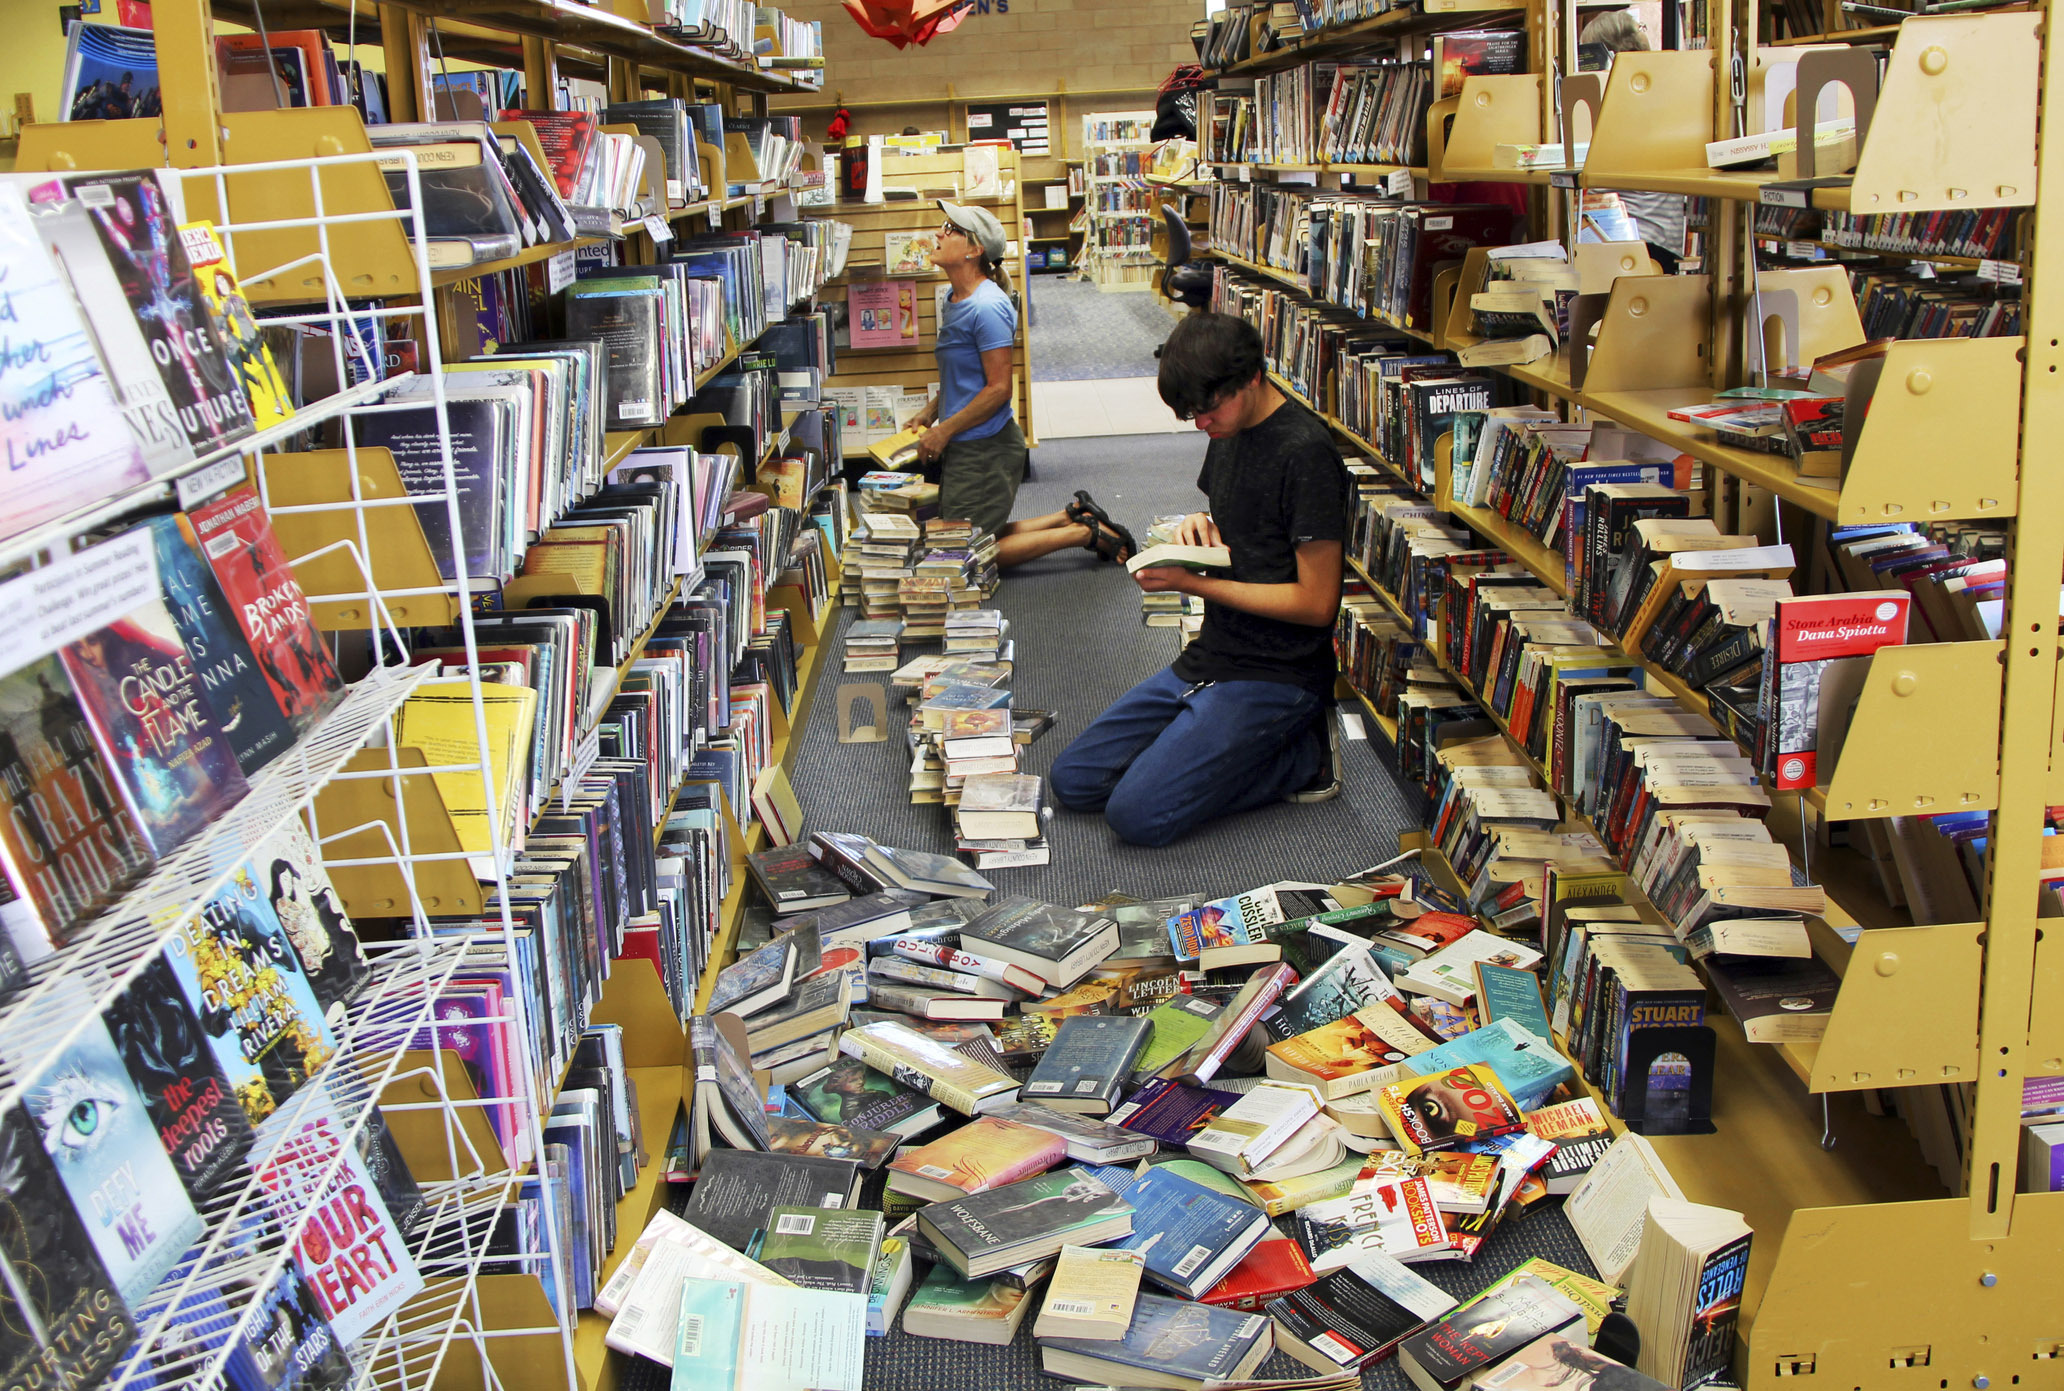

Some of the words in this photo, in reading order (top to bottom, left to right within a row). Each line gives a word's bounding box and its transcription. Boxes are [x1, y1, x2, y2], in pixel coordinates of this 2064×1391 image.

[435, 151, 456, 162] KERN
[1764, 191, 1785, 203] FICTION
[151, 327, 213, 366] ONCE
[187, 368, 203, 389] &
[1436, 387, 1464, 395] LINES
[1470, 385, 1483, 393] OF
[179, 390, 246, 434] UTURE
[1429, 391, 1490, 414] DEPARTURE
[6, 421, 90, 471] Lines
[199, 506, 236, 535] JONATHAN
[1595, 516, 1605, 557] ROLLINS
[170, 594, 212, 631] AME
[244, 579, 304, 641] BROKEN
[262, 601, 305, 643] LANDS
[1786, 618, 1824, 631] Stone
[1825, 612, 1874, 628] Arabia
[185, 636, 206, 662] IS
[1796, 628, 1835, 642] Dana
[1835, 624, 1887, 642] Spiotta
[130, 657, 152, 676] THE
[120, 655, 194, 716] CANDLE
[141, 698, 208, 757] FLAME
[28, 735, 72, 781] FALL
[71, 719, 93, 749] OF
[10, 751, 117, 864] CRAZY
[36, 810, 148, 929] HOUSE
[1007, 854, 1026, 863] COUNTY
[1567, 884, 1618, 898] ALEXANDER
[170, 885, 259, 958] DEALING
[1180, 914, 1194, 937] ZERO
[1237, 894, 1264, 942] CUSSLER
[217, 929, 243, 960] IN
[951, 949, 981, 969] BOY
[1186, 935, 1200, 961] HOUR
[201, 935, 284, 1014] DREAMS
[1128, 975, 1181, 994] LINCOLN
[1133, 984, 1181, 1001] LETTER
[242, 1003, 299, 1060] RIVERA
[1631, 1006, 1702, 1024] STUART
[163, 1076, 194, 1112] the
[1347, 1076, 1371, 1091] PAULA
[1371, 1070, 1395, 1086] McLAIN
[161, 1076, 225, 1155] deepest
[859, 1099, 914, 1132] RIDDLE
[1387, 1085, 1432, 1145] BOOKSHOTS
[1531, 1103, 1587, 1127] MICHAEL
[1535, 1114, 1595, 1139] NIEMANN
[183, 1116, 228, 1173] roots
[89, 1158, 142, 1229] DEFY
[892, 1204, 909, 1213] DAVID
[1413, 1179, 1427, 1204] JAMES
[1422, 1201, 1442, 1243] PATTERSON
[291, 1184, 382, 1267] OUR
[403, 1198, 425, 1231] JENSEN
[949, 1203, 1002, 1247] WOLFSBANE
[1402, 1180, 1433, 1245] BOOKSHOTS
[116, 1202, 156, 1262] ME
[1700, 1255, 1739, 1285] VENGEANCE
[1739, 1249, 1749, 1264] OF
[912, 1302, 947, 1313] JENNIFER
[1518, 1295, 1546, 1318] KARIN
[1694, 1265, 1746, 1314] RULES
[1494, 1292, 1549, 1335] SLAUGHTER
[255, 1344, 276, 1374] OF
[273, 1319, 297, 1354] THE
[295, 1324, 331, 1373] STARS
[1430, 1332, 1471, 1366] WOMAN
[1438, 1321, 1461, 1342] THE
[1462, 1340, 1490, 1363] KEPT
[1684, 1320, 1738, 1372] REICH
